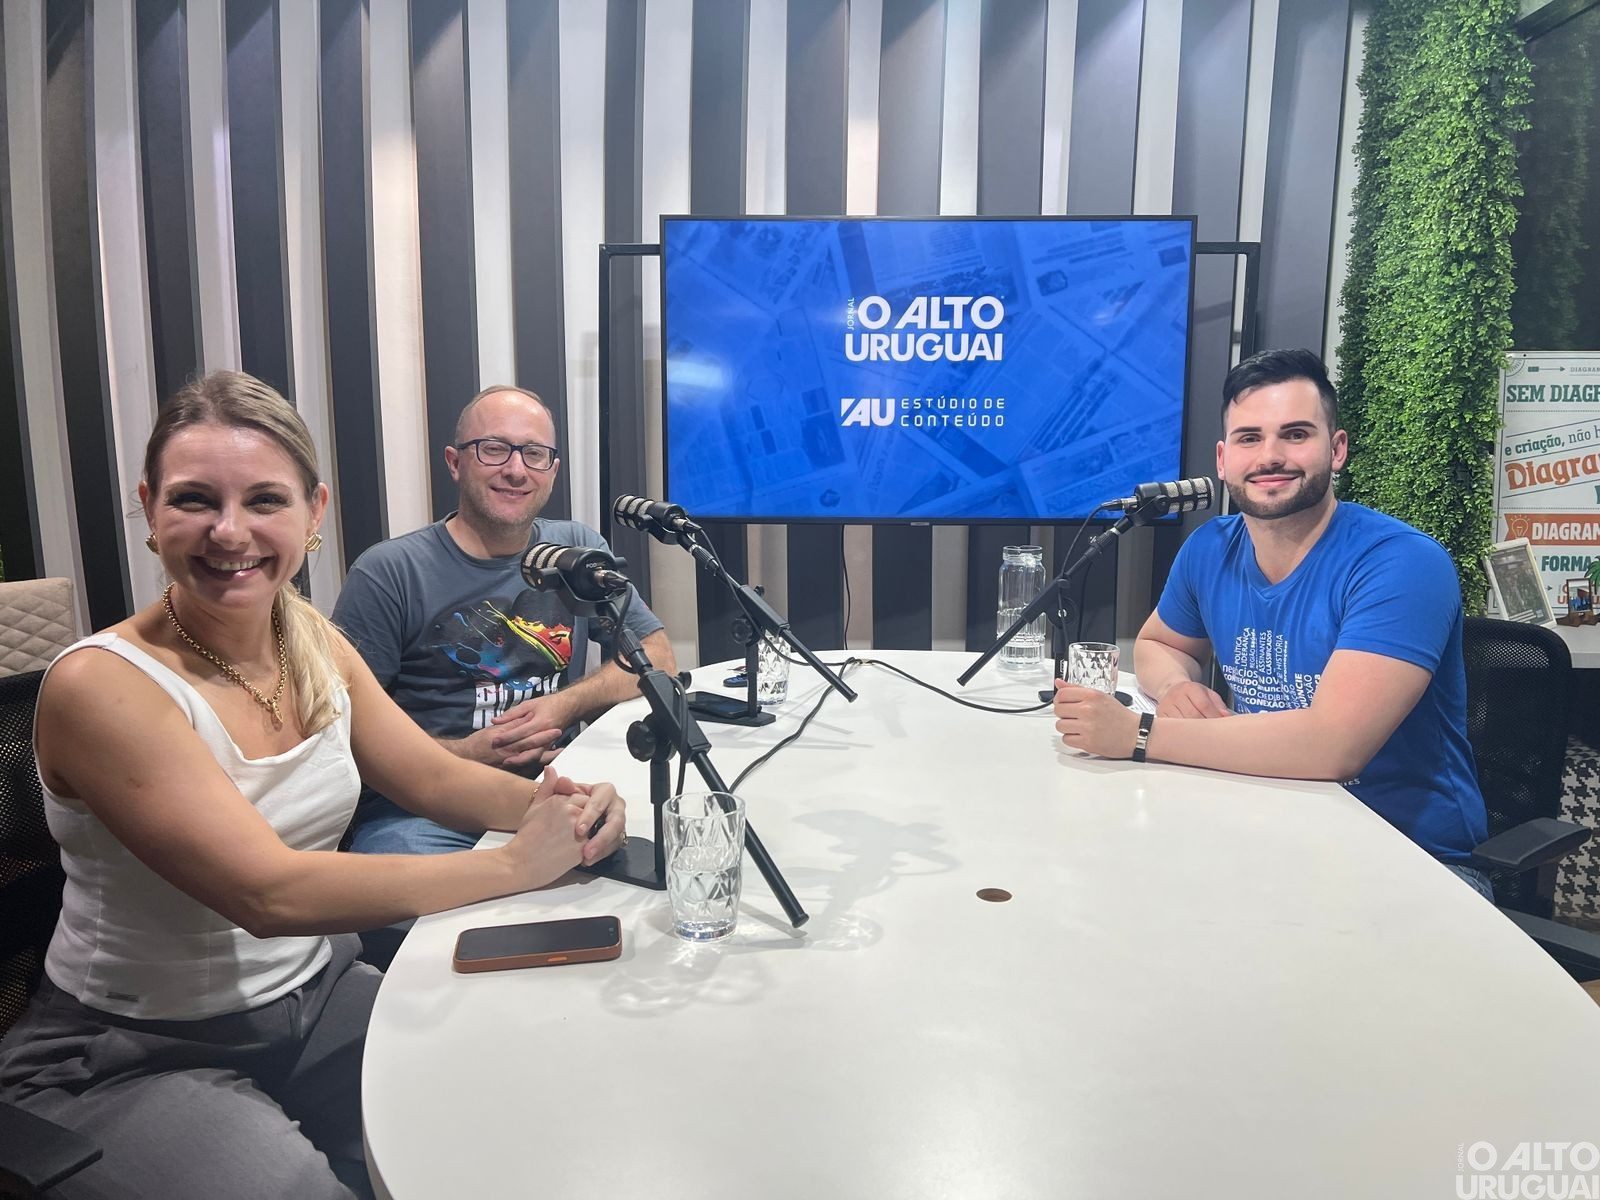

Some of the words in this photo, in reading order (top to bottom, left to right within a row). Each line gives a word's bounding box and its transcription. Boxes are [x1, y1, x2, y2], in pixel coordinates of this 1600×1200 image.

[847, 297, 855, 330] JORNAL
[857, 295, 891, 330] O
[894, 295, 1005, 330] ALTO
[845, 333, 1003, 362] URUGUAI
[901, 395, 977, 409] ESTÚDIO
[984, 398, 1005, 409] DE
[1506, 384, 1546, 403] SEM
[900, 412, 1004, 427] CONTEÚDO
[1504, 446, 1512, 456] e
[1515, 434, 1565, 454] criação,
[1568, 428, 1592, 444] não
[1504, 454, 1600, 490] Diagra
[1258, 632, 1267, 673] ASSINANTES
